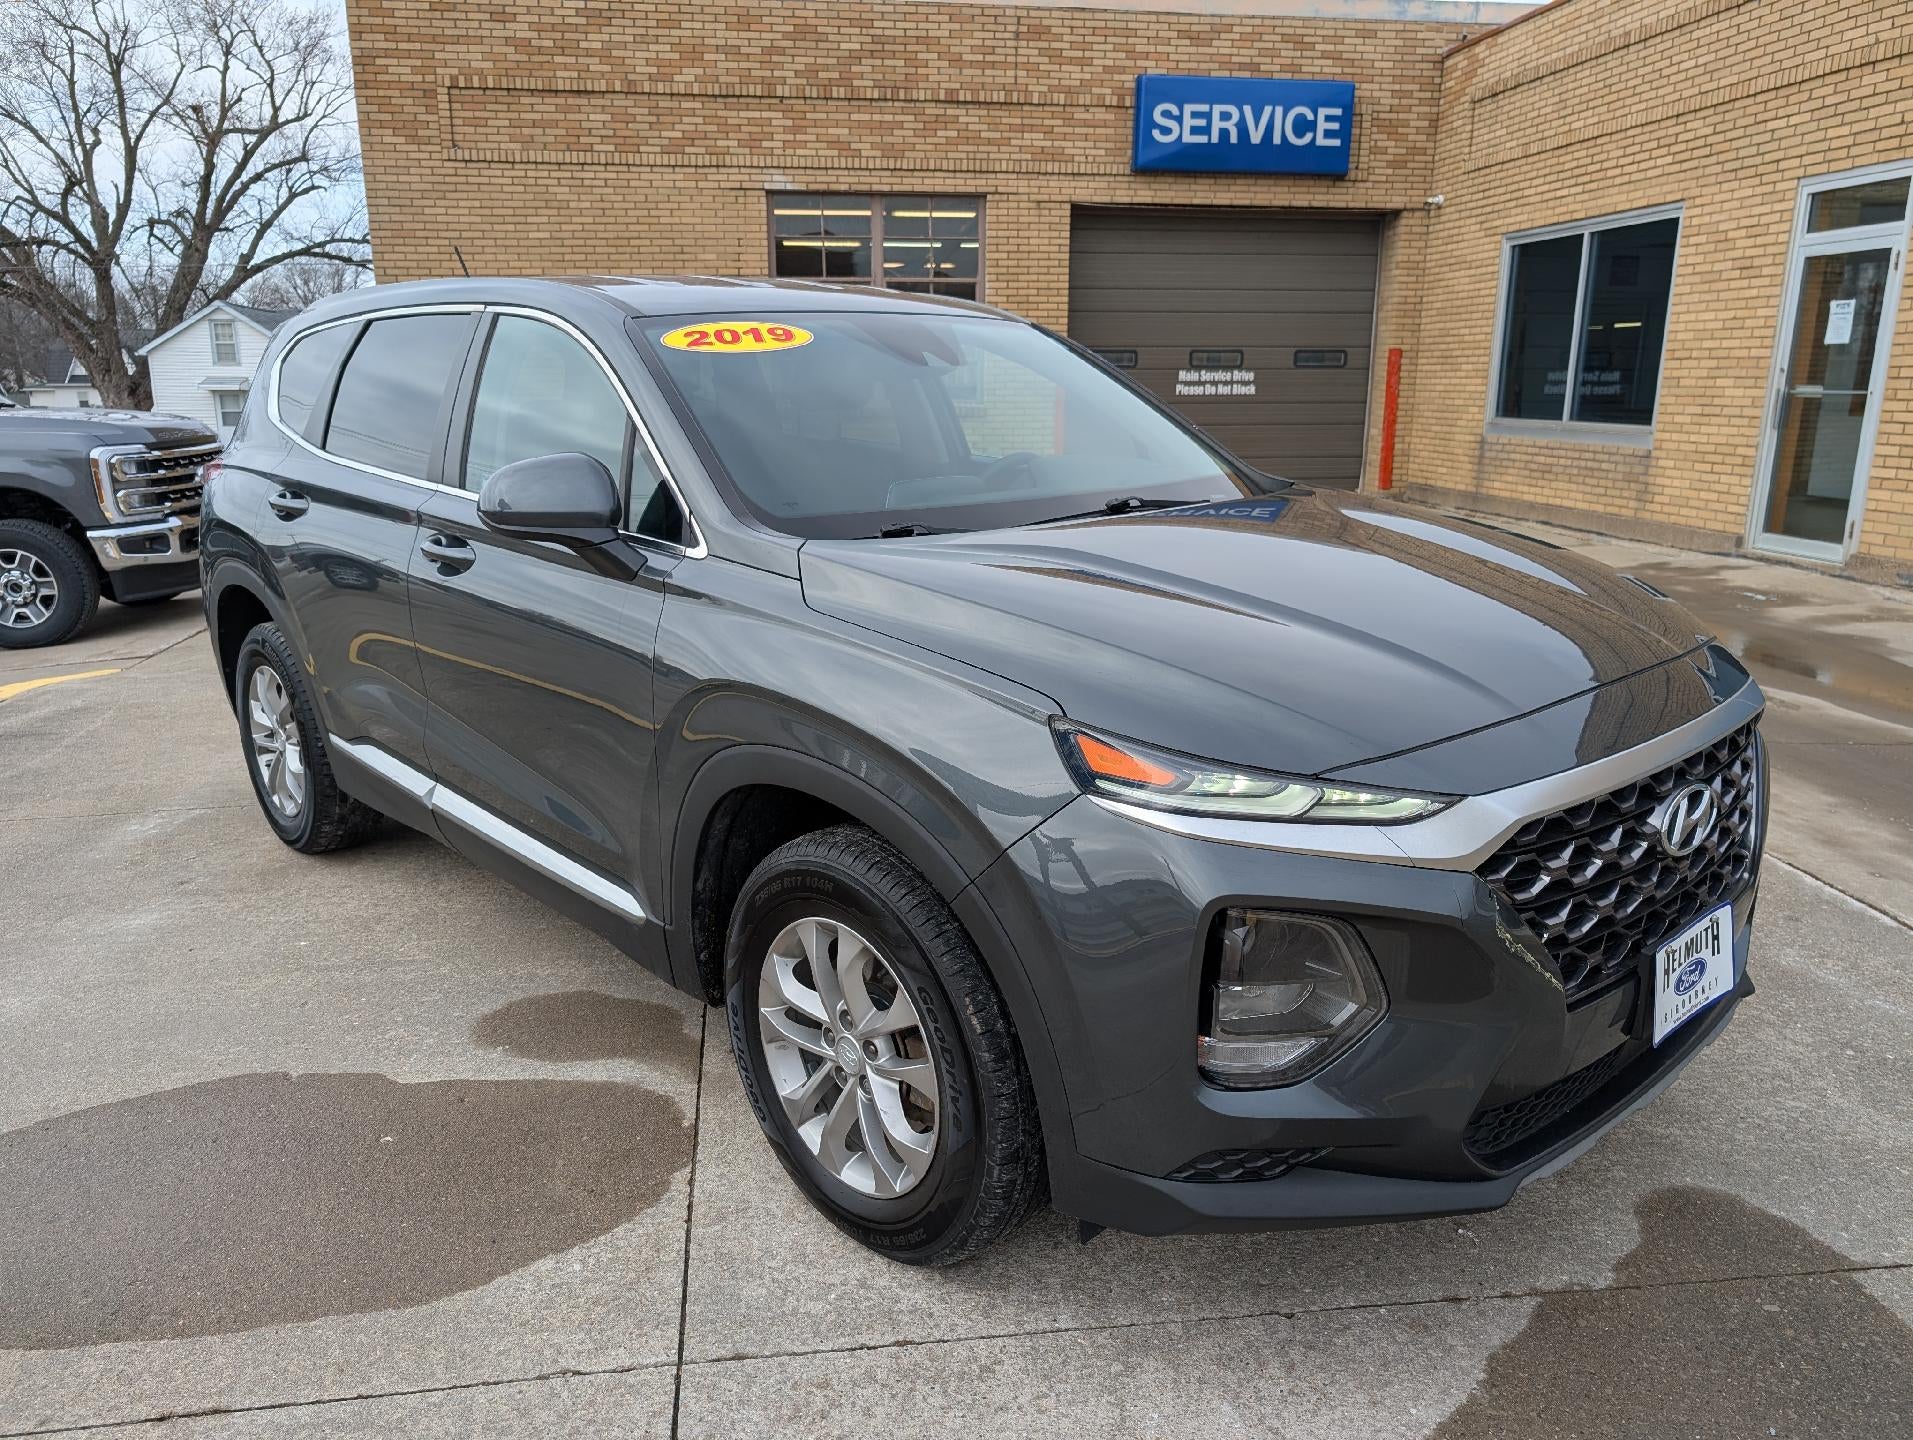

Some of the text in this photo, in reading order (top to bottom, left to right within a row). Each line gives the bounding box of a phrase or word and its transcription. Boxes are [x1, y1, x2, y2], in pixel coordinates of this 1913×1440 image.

[1152, 103, 1342, 147] SERVICE
[683, 326, 796, 348] 2019
[1178, 369, 1255, 382] Main Service Drive
[1175, 382, 1256, 396] Please Do Not Block
[1663, 917, 1721, 994] HELMUTH
[1678, 962, 1703, 992] Ford
